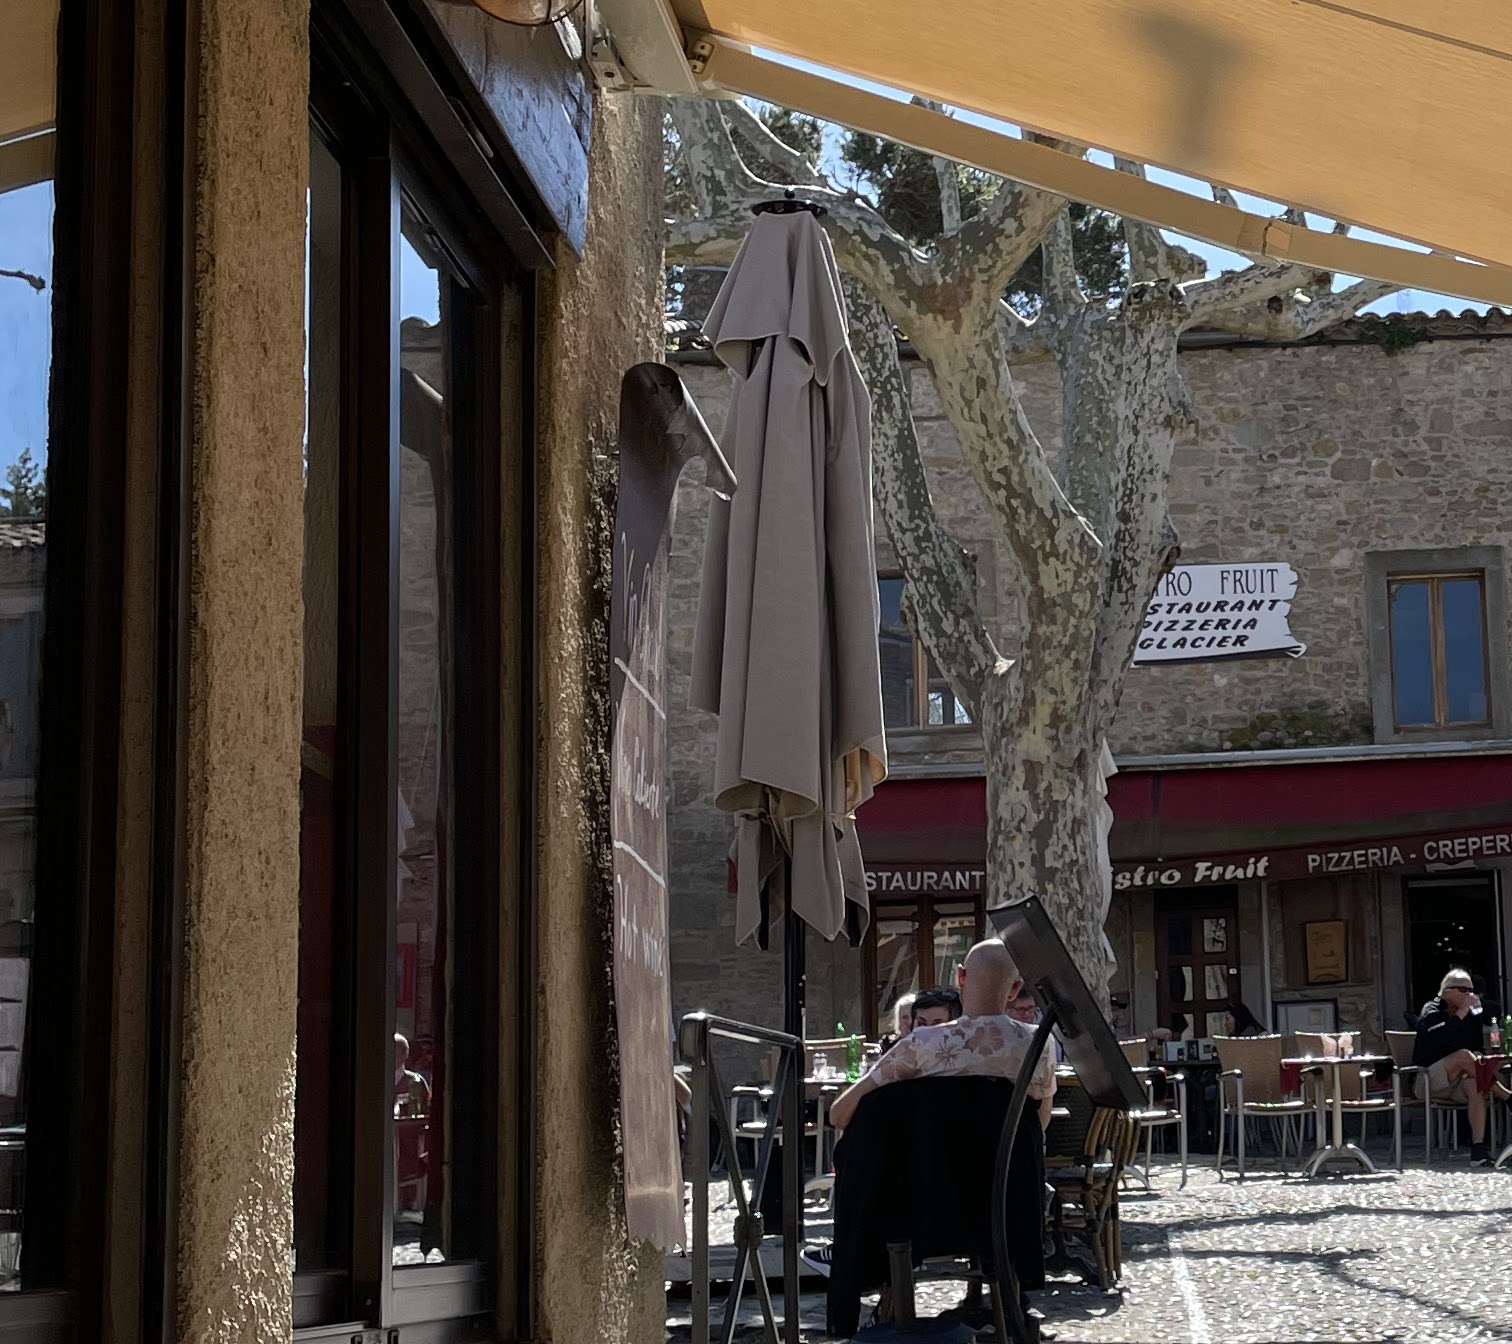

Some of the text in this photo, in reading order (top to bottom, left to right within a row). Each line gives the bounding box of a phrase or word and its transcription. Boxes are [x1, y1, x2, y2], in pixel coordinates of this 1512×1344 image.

[1220, 568, 1279, 596] FRUIT
[1141, 617, 1259, 634] PIZZERIA
[1138, 634, 1250, 650] GLACIER
[1193, 855, 1270, 884] Fruit
[1307, 845, 1405, 874] PIZZERIA
[616, 872, 639, 966] Hot
